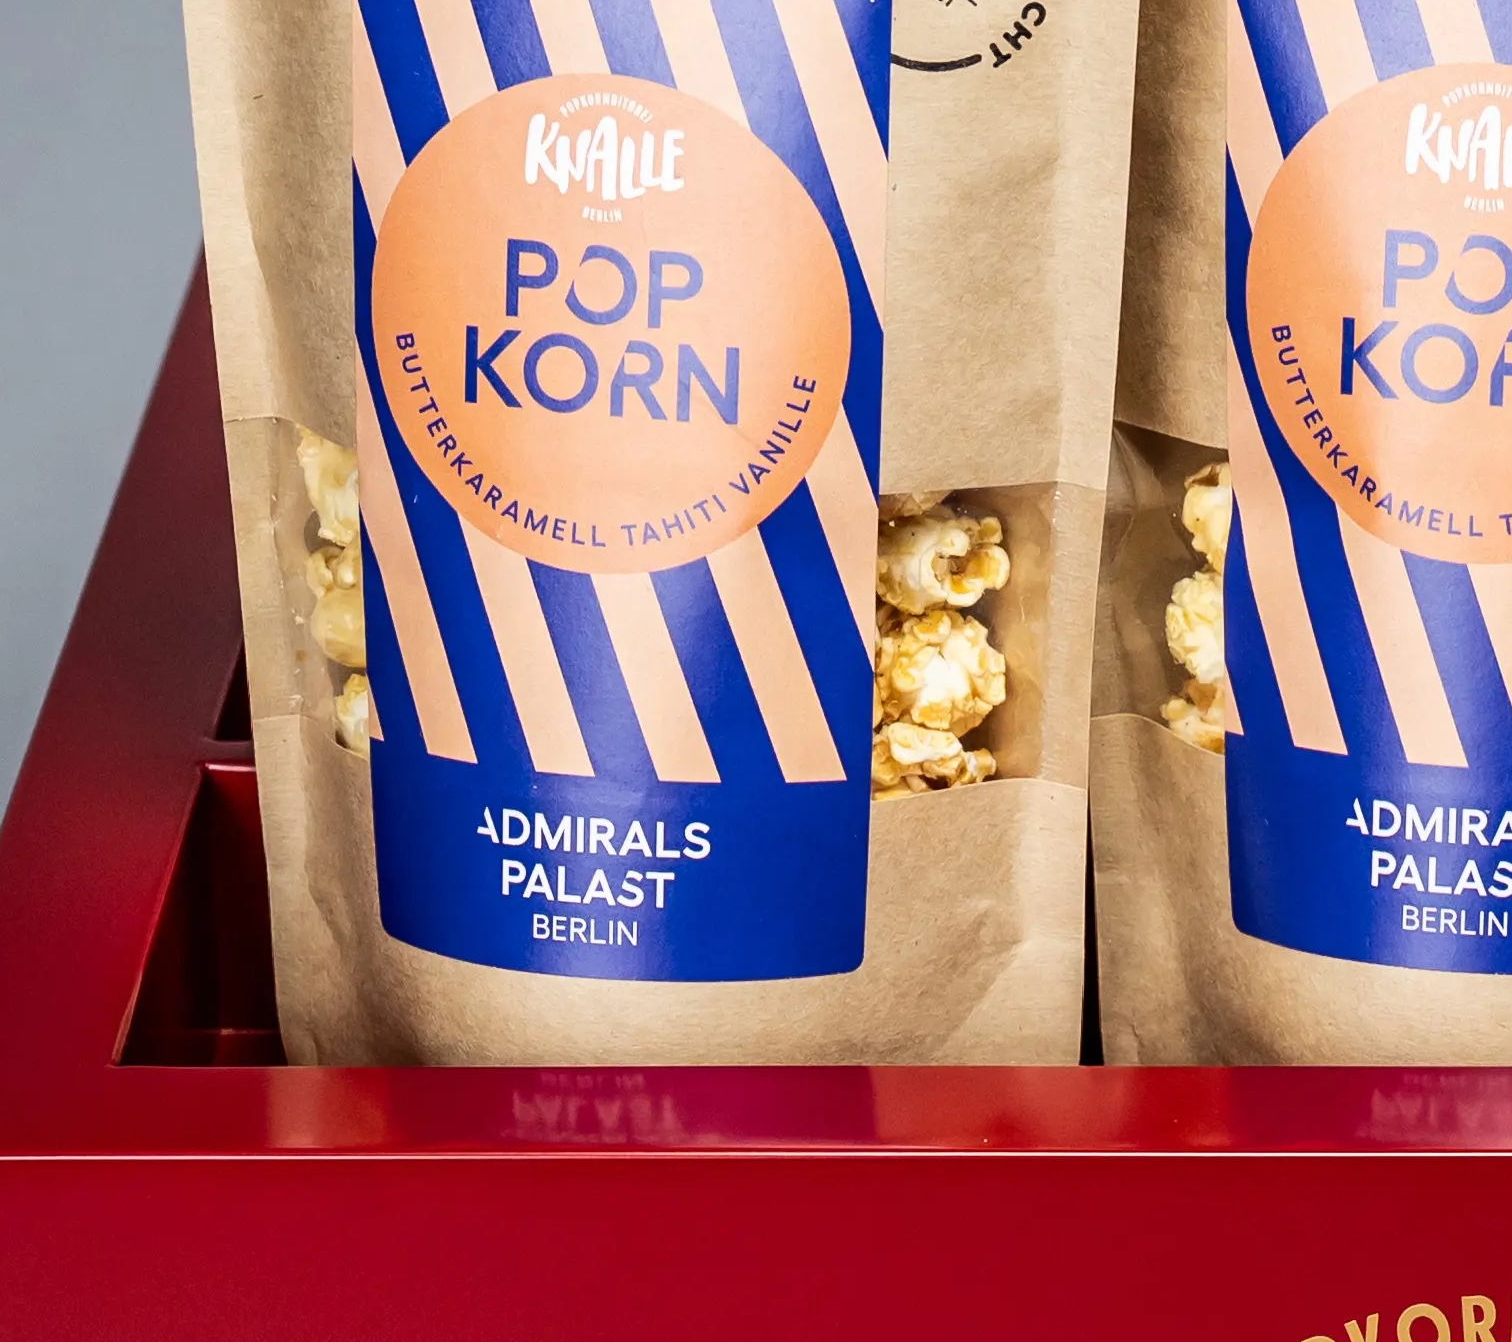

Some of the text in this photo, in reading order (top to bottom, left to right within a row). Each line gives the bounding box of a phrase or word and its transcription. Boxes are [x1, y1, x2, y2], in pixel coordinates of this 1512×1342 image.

[524, 113, 685, 201] KNALLE
[582, 206, 623, 222] BERLIN
[1463, 195, 1505, 212] BERLIN
[504, 237, 704, 330] POP
[462, 325, 741, 426] KORN
[393, 332, 818, 549] BUTTERKARAMELL TAHITI VANILLE
[1270, 324, 1485, 539] BUTTERKARAMELL
[476, 806, 711, 859] ADMIRALS
[501, 859, 675, 909] PALAST
[532, 913, 639, 947] BERLIN
[1401, 904, 1509, 937] BERLIN
